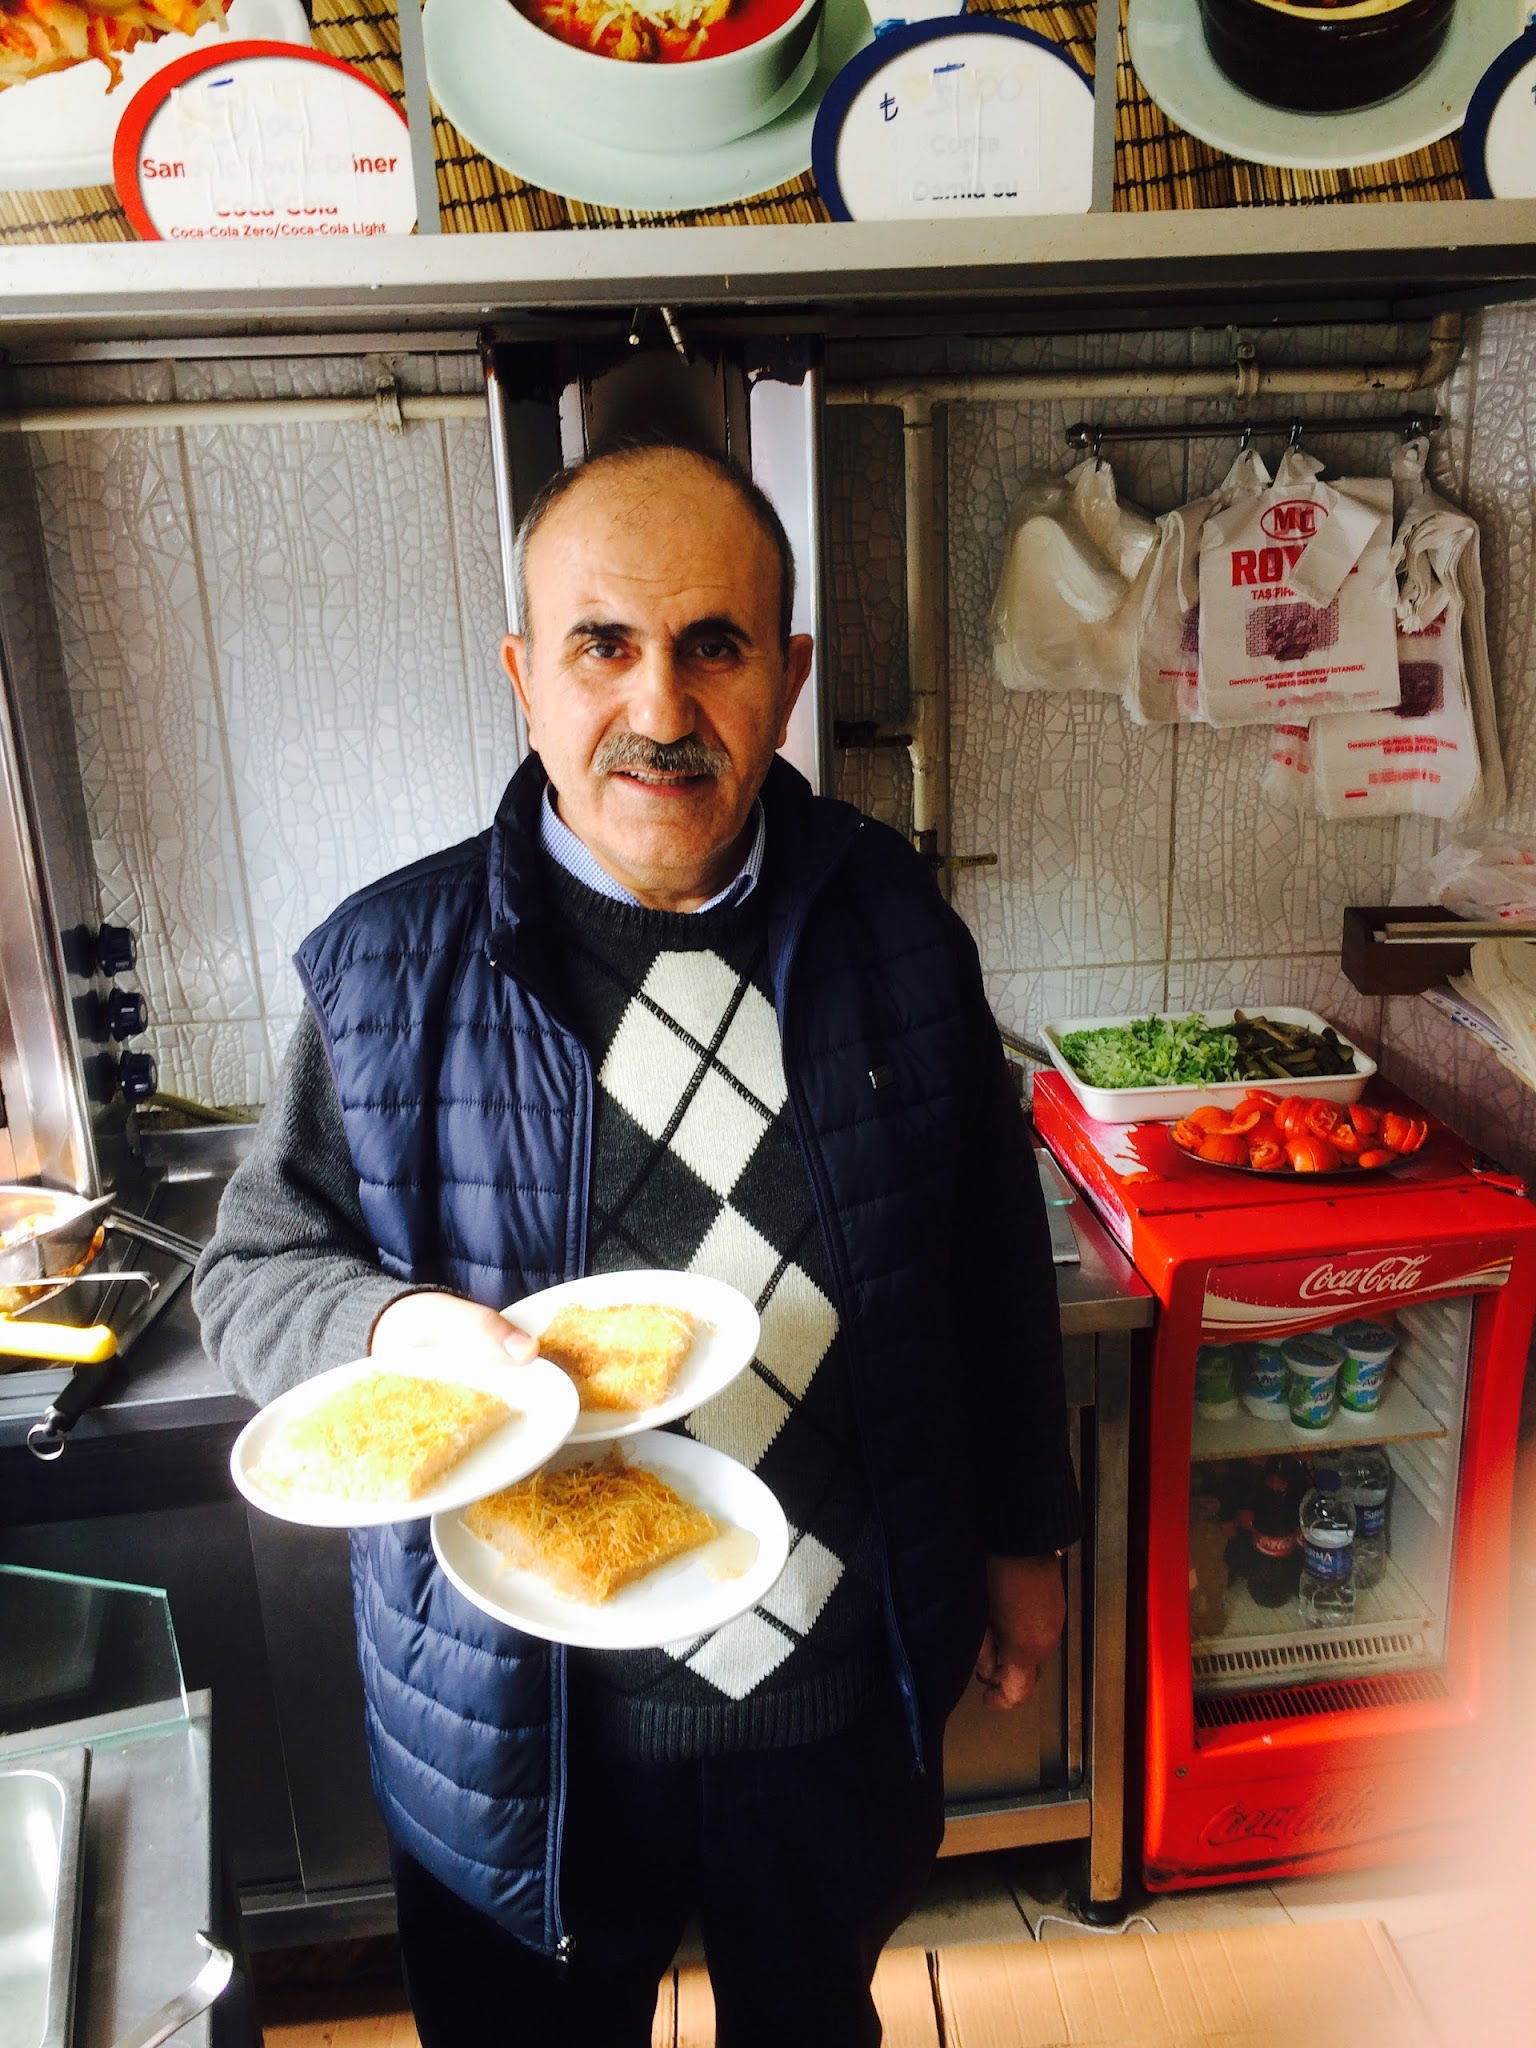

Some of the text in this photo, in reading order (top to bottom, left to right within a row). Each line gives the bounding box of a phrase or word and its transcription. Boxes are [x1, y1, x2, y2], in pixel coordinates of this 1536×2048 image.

[170, 226, 240, 239] Coca-Cola
[352, 221, 387, 236] Light
[1231, 543, 1310, 587] ROY
[1300, 1254, 1432, 1300] Coca-Cola
